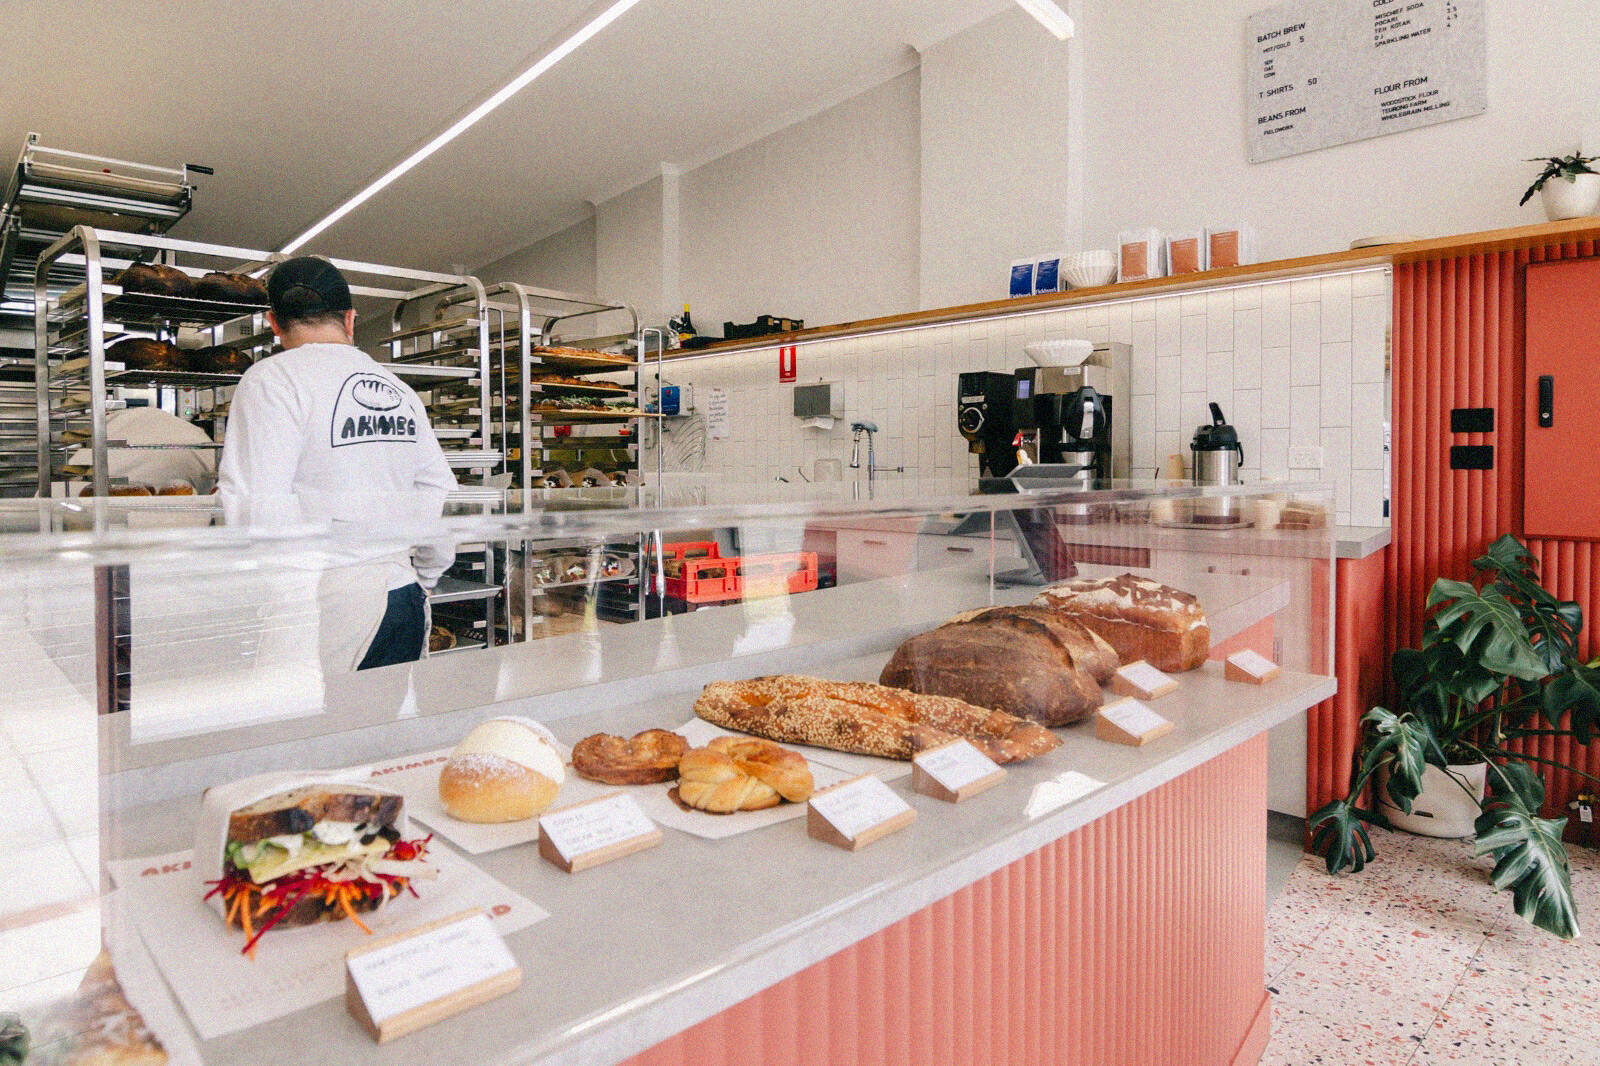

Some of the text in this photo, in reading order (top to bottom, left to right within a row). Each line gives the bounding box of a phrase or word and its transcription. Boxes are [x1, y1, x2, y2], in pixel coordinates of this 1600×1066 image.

[1257, 22, 1306, 43] BATCH BREW
[1374, 34, 1409, 48] SPARKLING
[1410, 27, 1432, 37] WATER
[1266, 84, 1294, 97] SHIRTS
[1307, 77, 1318, 86] 50
[1374, 76, 1428, 95] FLOUR FROM
[1380, 89, 1439, 107] WOODSTOCK FLOUR
[1410, 100, 1428, 108] FARM
[1257, 106, 1306, 124] BEANS FROM
